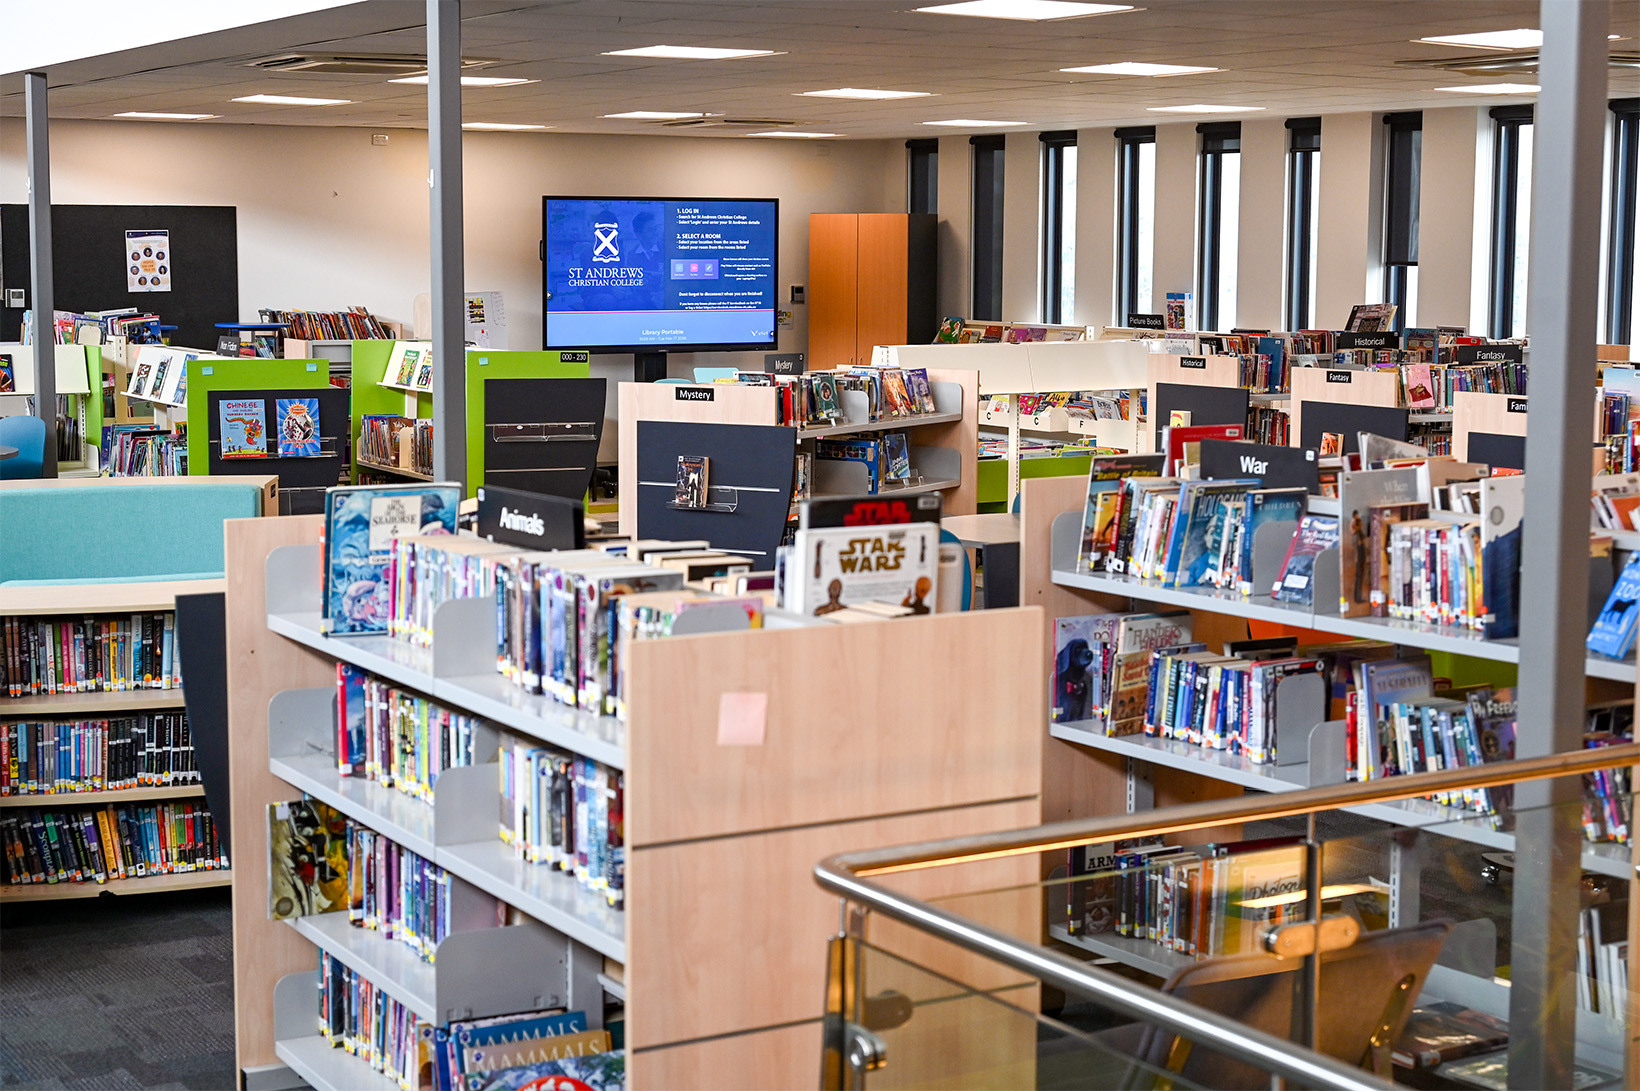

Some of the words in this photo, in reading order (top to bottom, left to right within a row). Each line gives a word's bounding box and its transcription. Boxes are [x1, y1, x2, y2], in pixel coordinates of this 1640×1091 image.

[568, 268, 583, 278] ST
[585, 268, 644, 278] ANDREWS
[1354, 338, 1385, 346] Historical
[1477, 351, 1505, 360] Fantasy
[775, 360, 793, 371] Mystery
[1329, 373, 1350, 382] Fantasy
[680, 390, 711, 400] Mystery
[986, 412, 992, 420] C
[1034, 417, 1039, 425] C
[1240, 456, 1268, 474] War
[373, 514, 416, 526] SEAHORSE
[499, 506, 545, 536] Animals
[839, 538, 905, 555] STAR
[840, 554, 905, 573] WARS
[39, 831, 54, 874] SCORPIA
